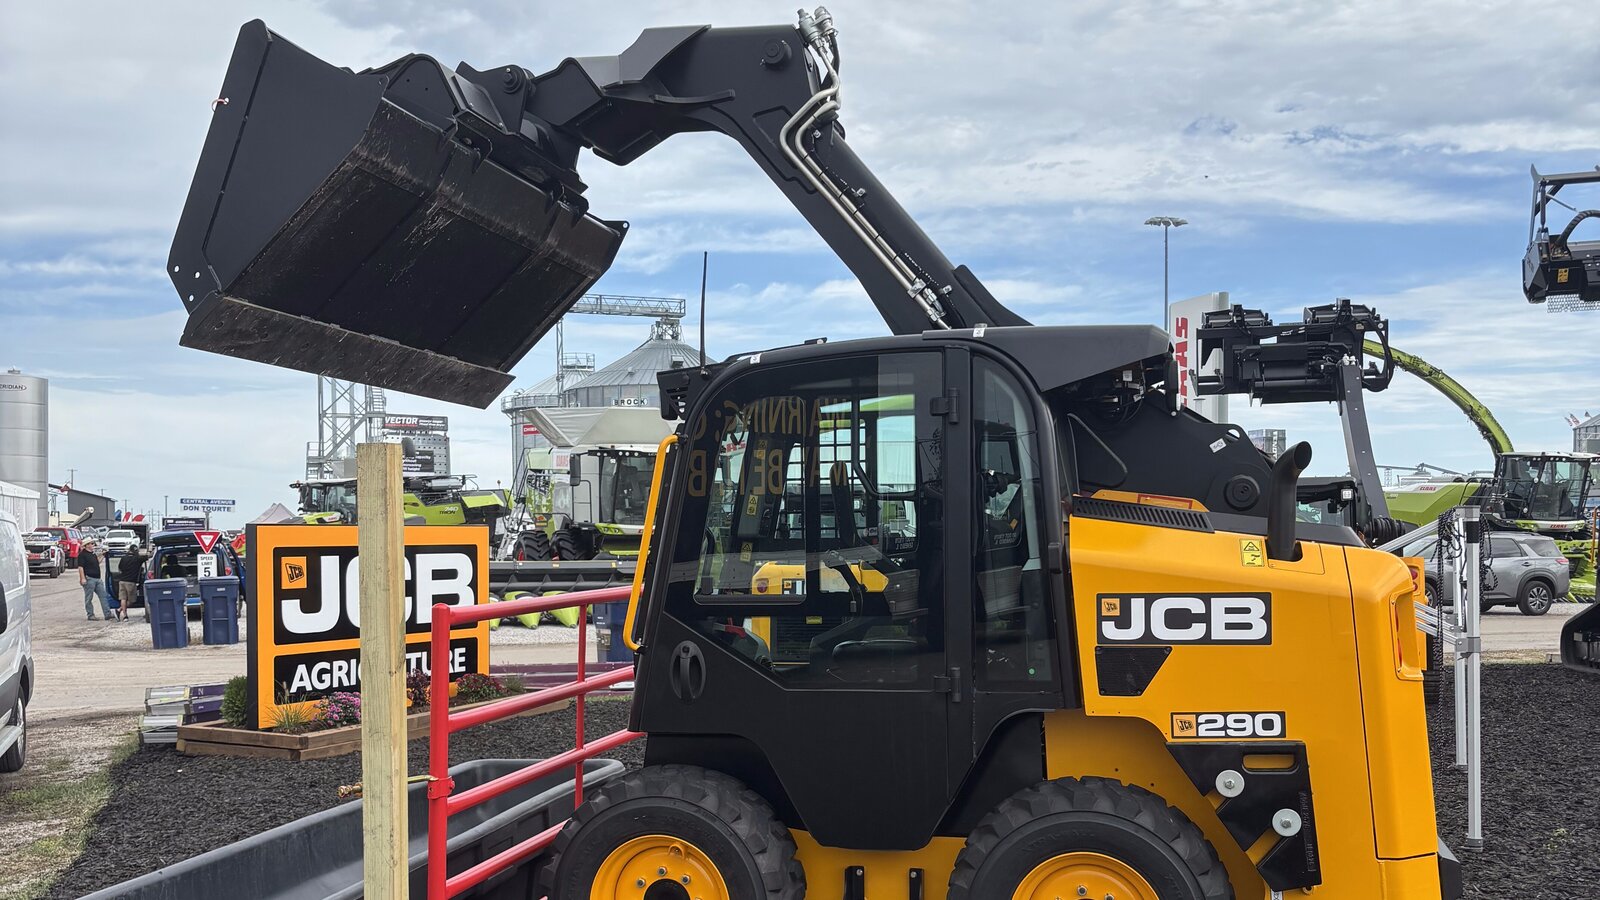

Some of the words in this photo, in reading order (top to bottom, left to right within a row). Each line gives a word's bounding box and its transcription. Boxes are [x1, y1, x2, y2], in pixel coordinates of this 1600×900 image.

[384, 416, 418, 425] VECTOR
[203, 567, 211, 578] 5
[1102, 597, 1268, 641] JCB
[1197, 713, 1282, 737] 290
